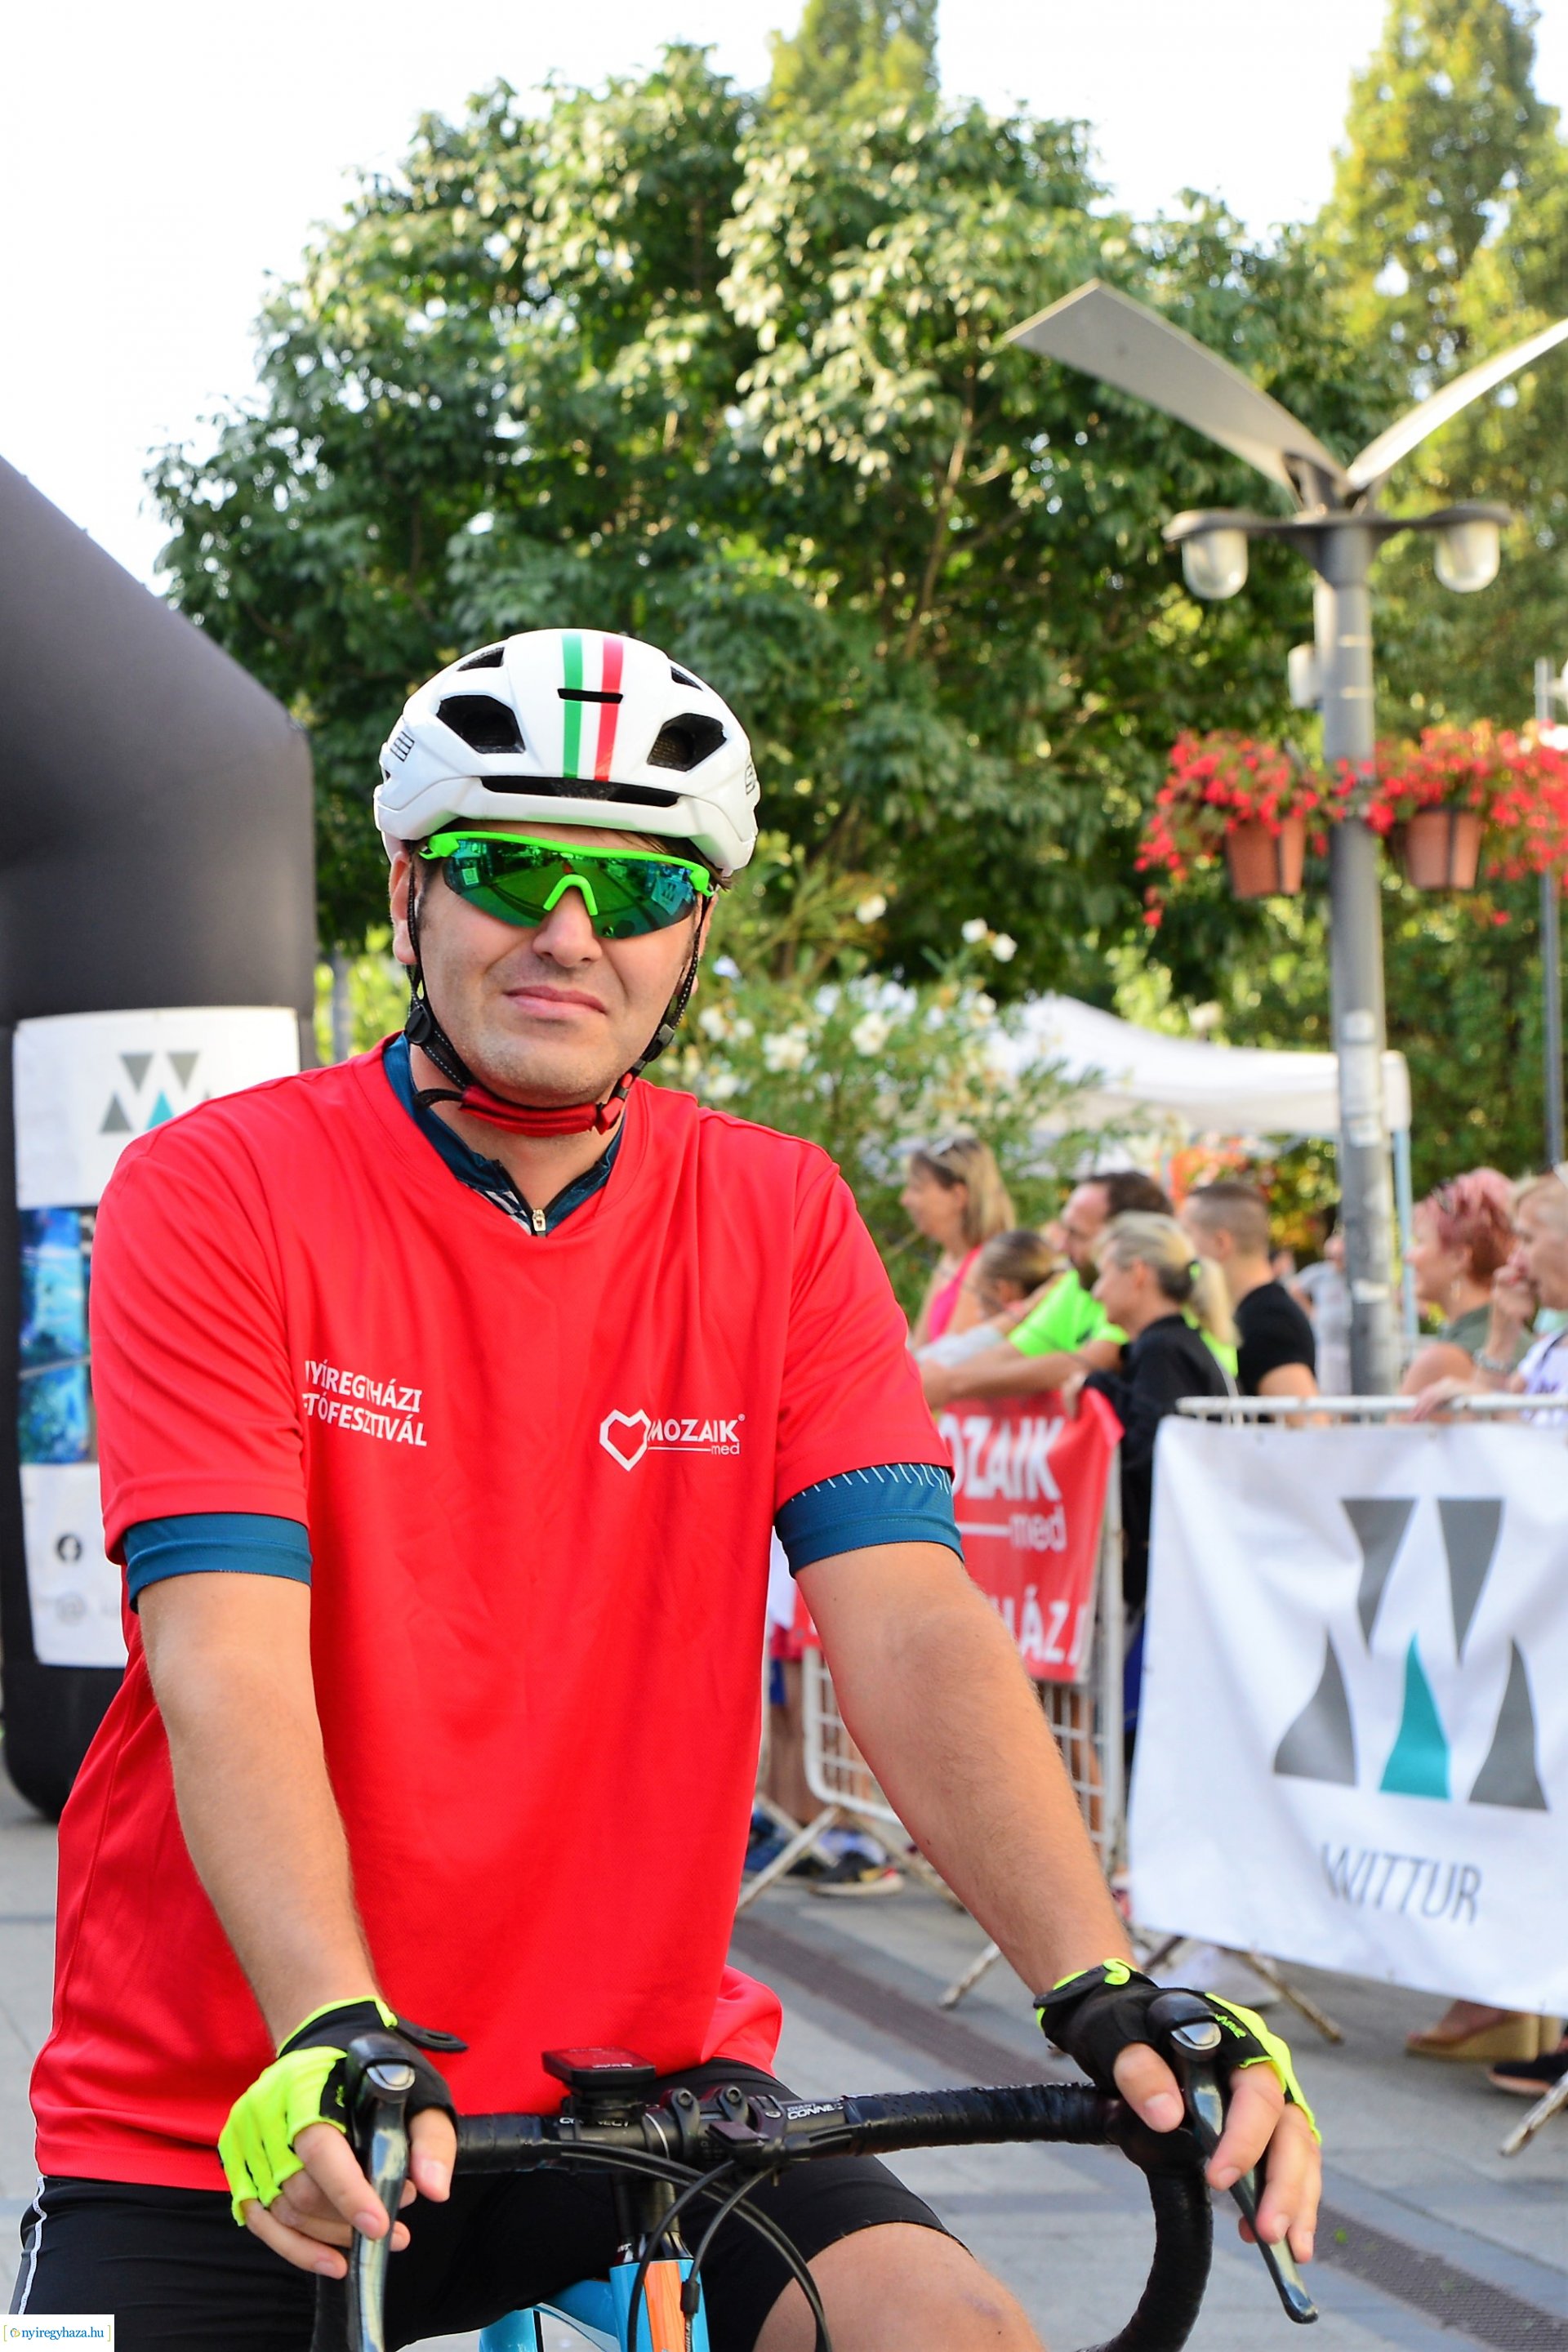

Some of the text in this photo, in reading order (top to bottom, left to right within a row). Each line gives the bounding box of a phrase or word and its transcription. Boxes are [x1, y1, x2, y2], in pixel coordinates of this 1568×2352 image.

[648, 1419, 740, 1442] MOZAIK
[710, 1442, 740, 1454] med
[939, 1414, 1062, 1500] OZAIK
[1009, 1504, 1067, 1551] med
[1321, 1842, 1482, 1925] WITTUR
